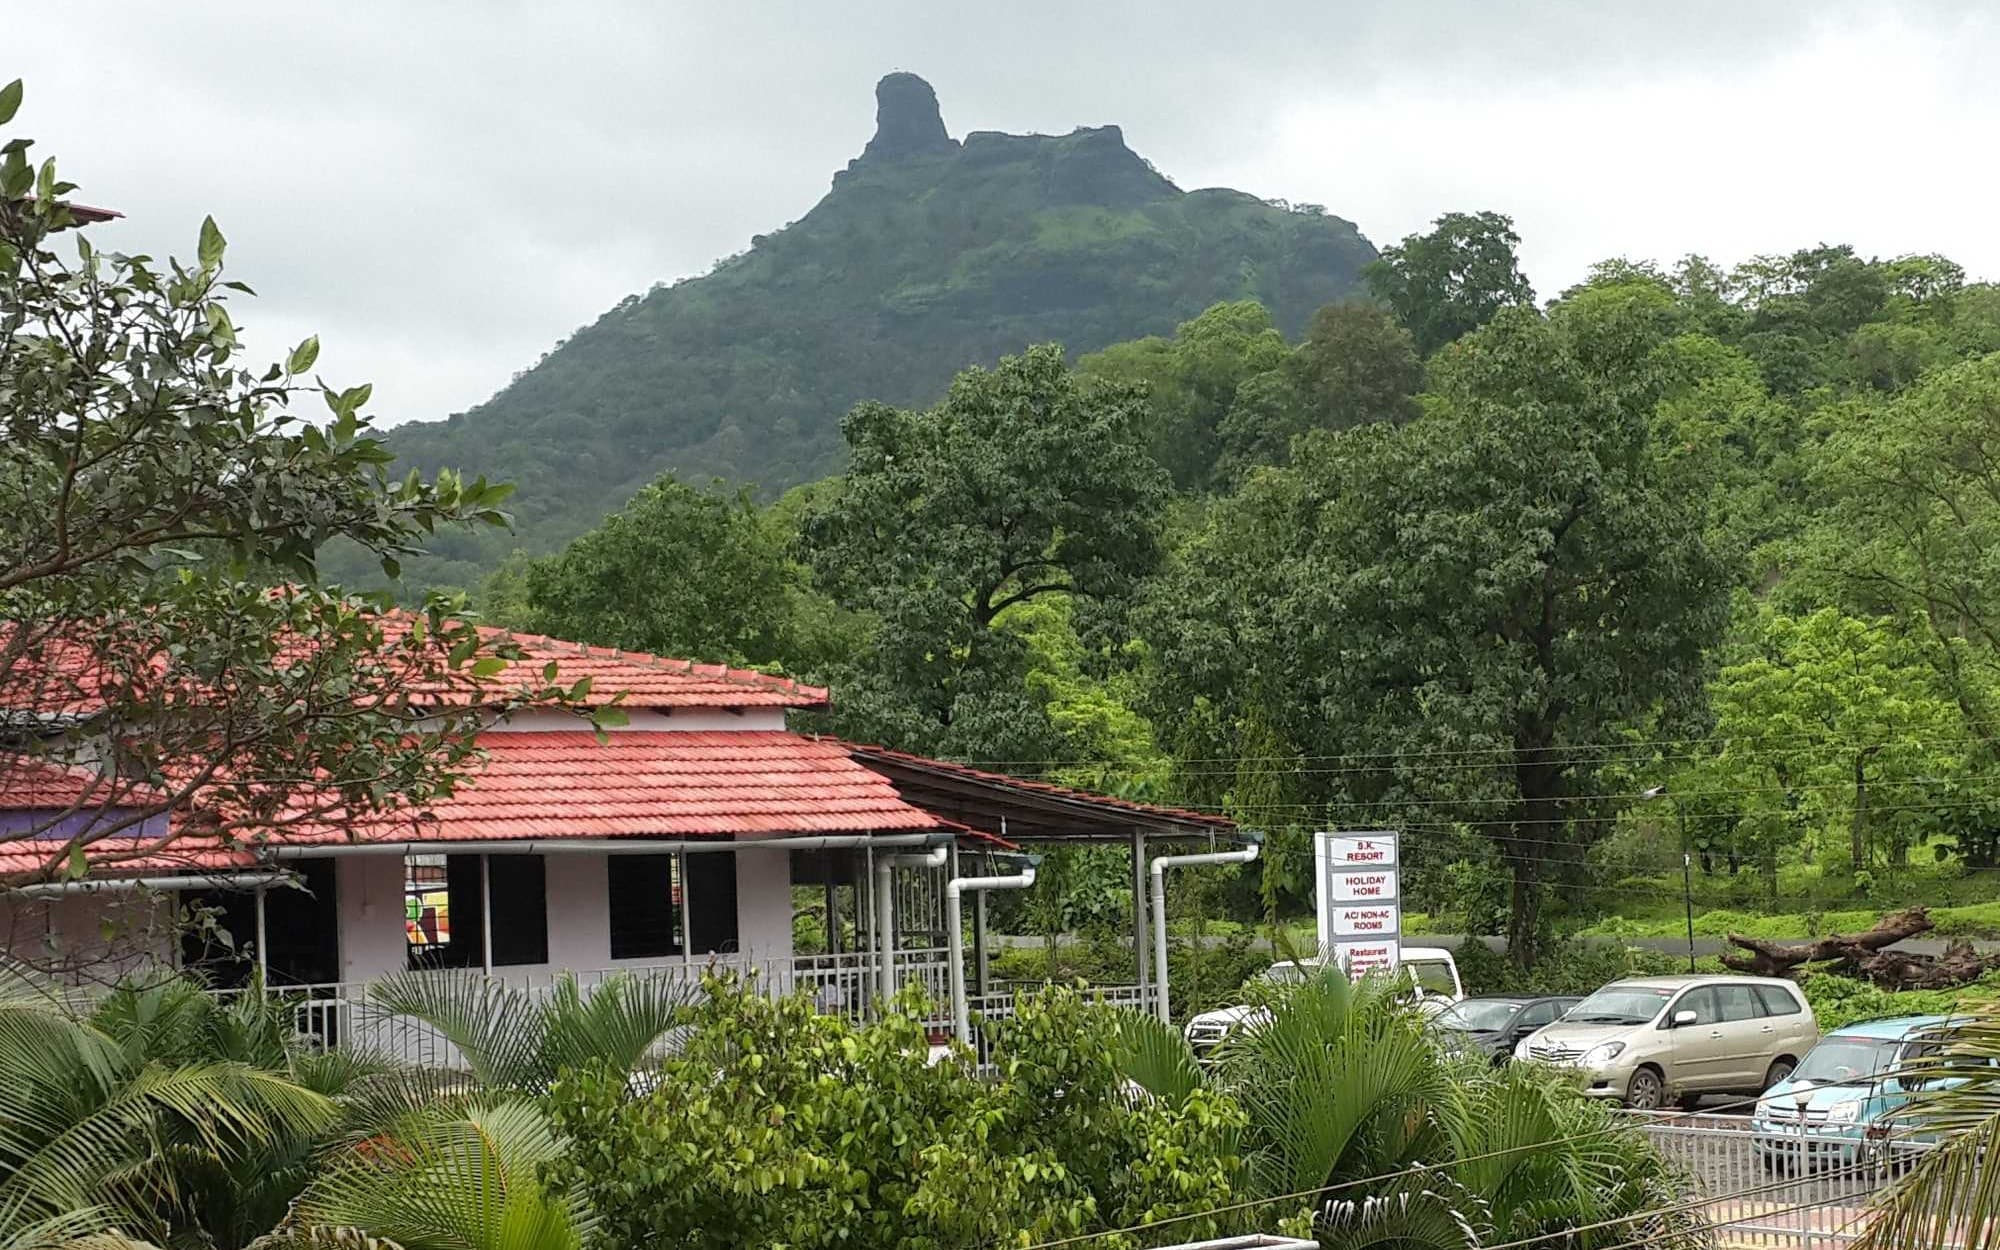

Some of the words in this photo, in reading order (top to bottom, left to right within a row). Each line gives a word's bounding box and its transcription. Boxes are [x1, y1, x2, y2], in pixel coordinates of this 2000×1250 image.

[1347, 852, 1384, 861] RESORT
[1345, 876, 1386, 885] HOLIDAY
[1353, 886, 1381, 895] HOME
[1361, 911, 1389, 919] NON-AC
[1354, 921, 1383, 930] ROOMS
[1350, 947, 1387, 956] Restaurant
